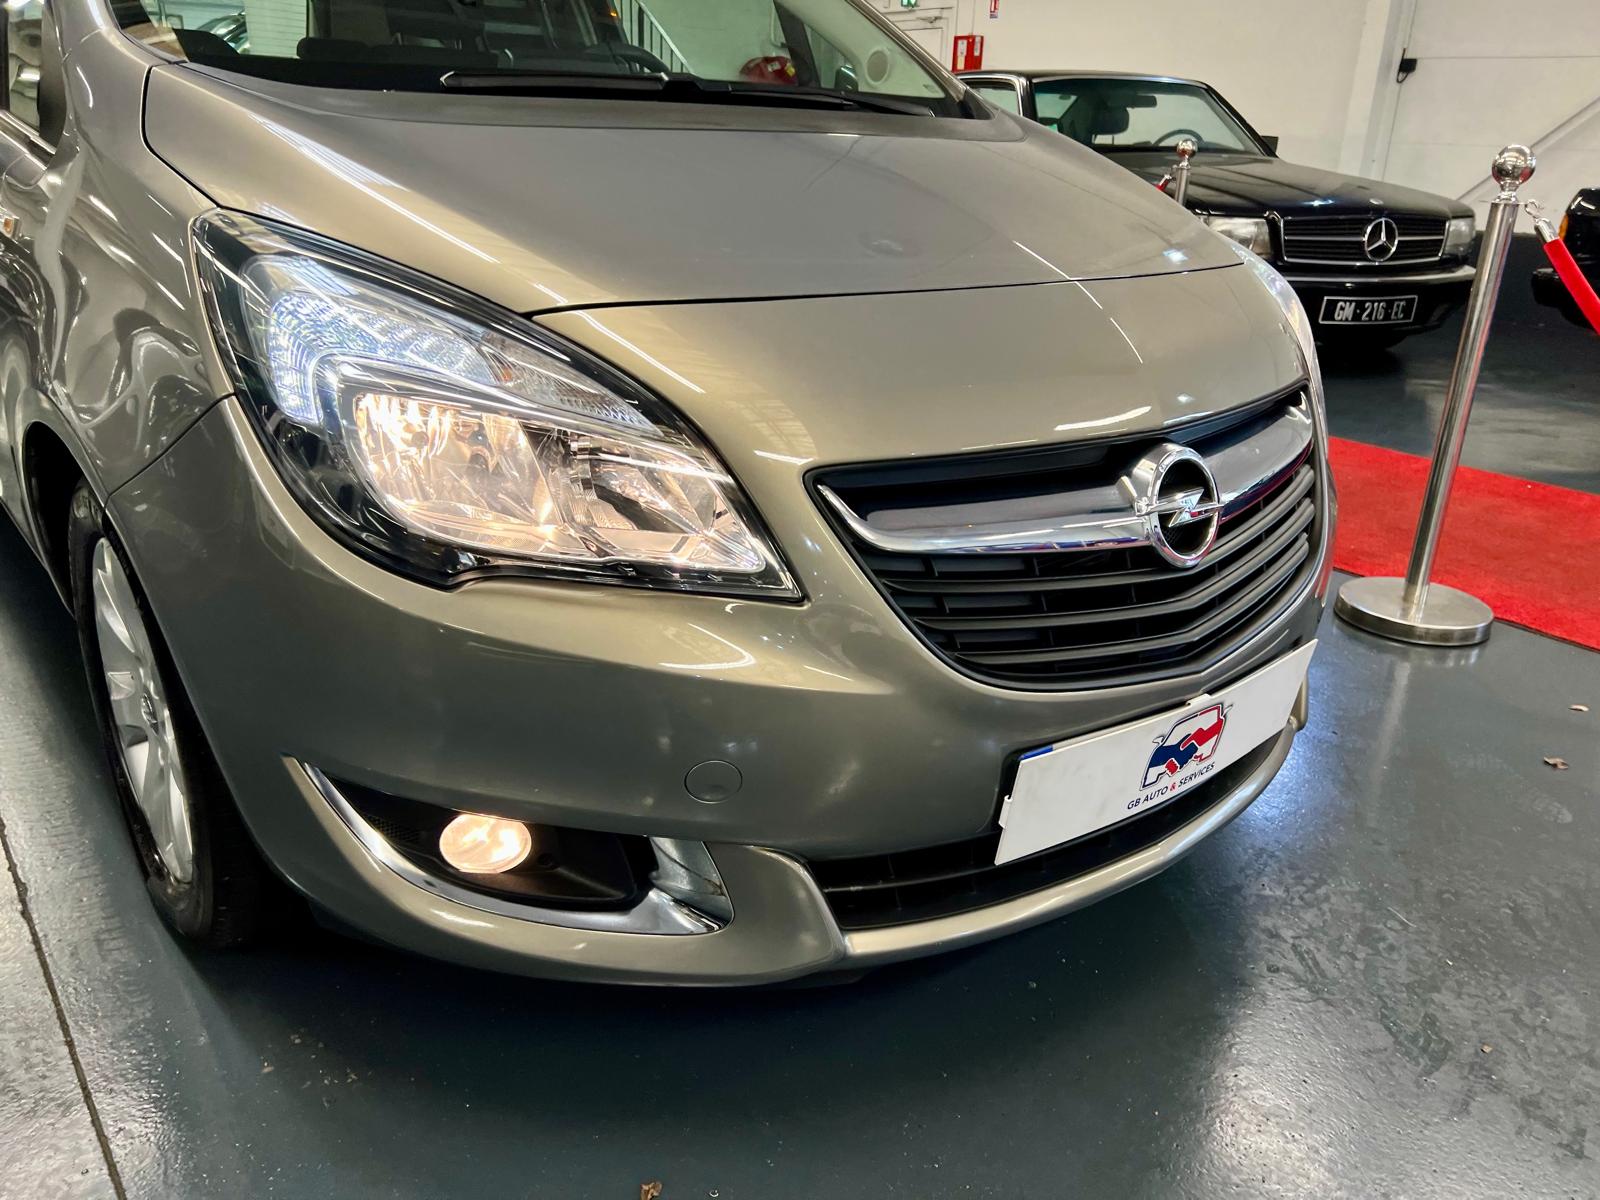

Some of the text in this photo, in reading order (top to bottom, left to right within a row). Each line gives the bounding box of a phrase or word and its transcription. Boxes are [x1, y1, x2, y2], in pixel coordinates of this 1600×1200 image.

[1334, 301, 1406, 321] GM 216 EC
[1127, 762, 1215, 810] GB AUTO & SERVICES
